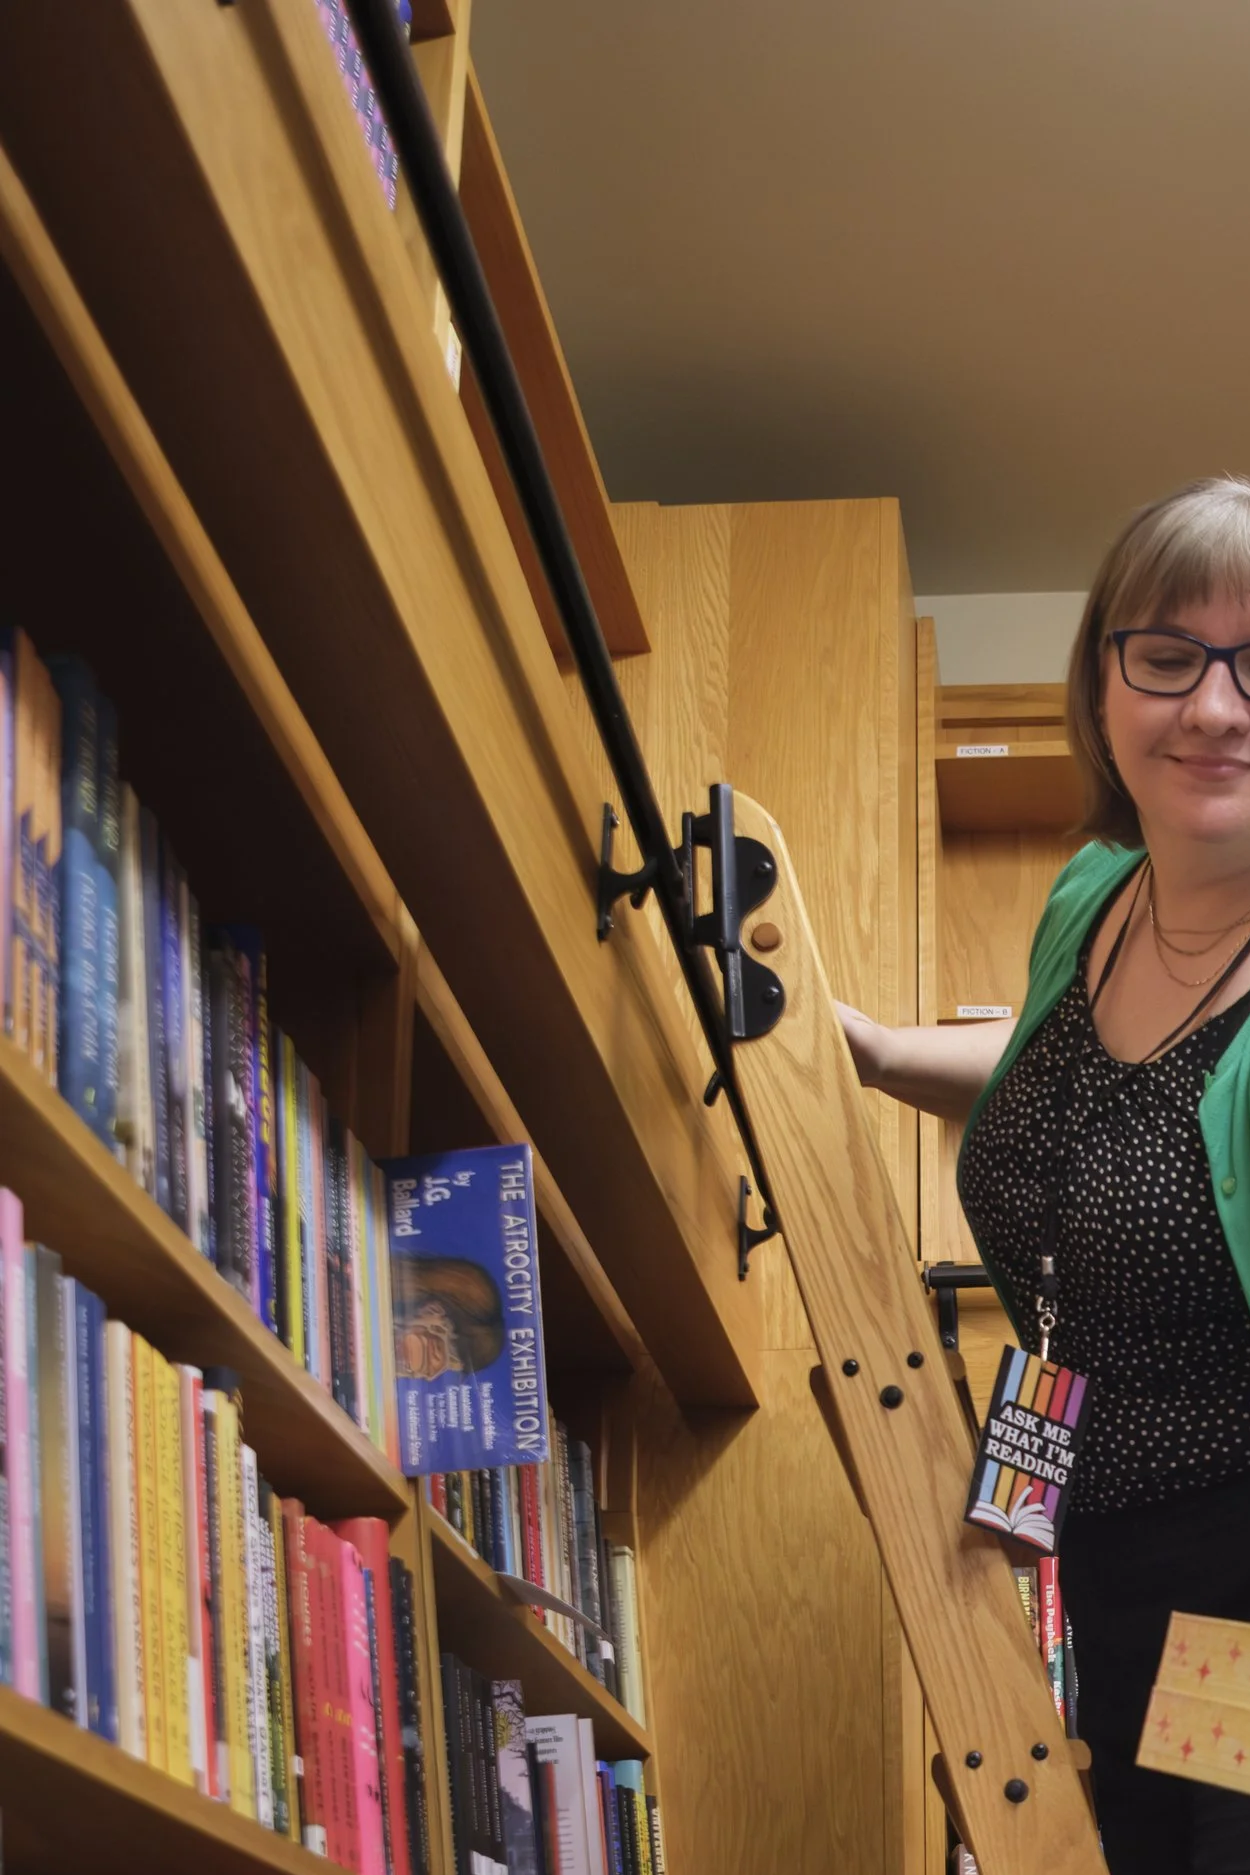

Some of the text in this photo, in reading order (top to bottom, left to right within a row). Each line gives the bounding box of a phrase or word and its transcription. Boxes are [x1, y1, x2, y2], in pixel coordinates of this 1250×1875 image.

[960, 747, 991, 755] FICTION
[425, 1177, 451, 1206] J.G.
[454, 1171, 476, 1187] by
[392, 1179, 421, 1237] Ballard
[500, 1160, 540, 1451] THE ATROCITY EXHIBITION
[990, 1418, 1076, 1469] WHAT I'M
[1000, 1405, 1071, 1446] ASK ME
[985, 1439, 1069, 1487] READING
